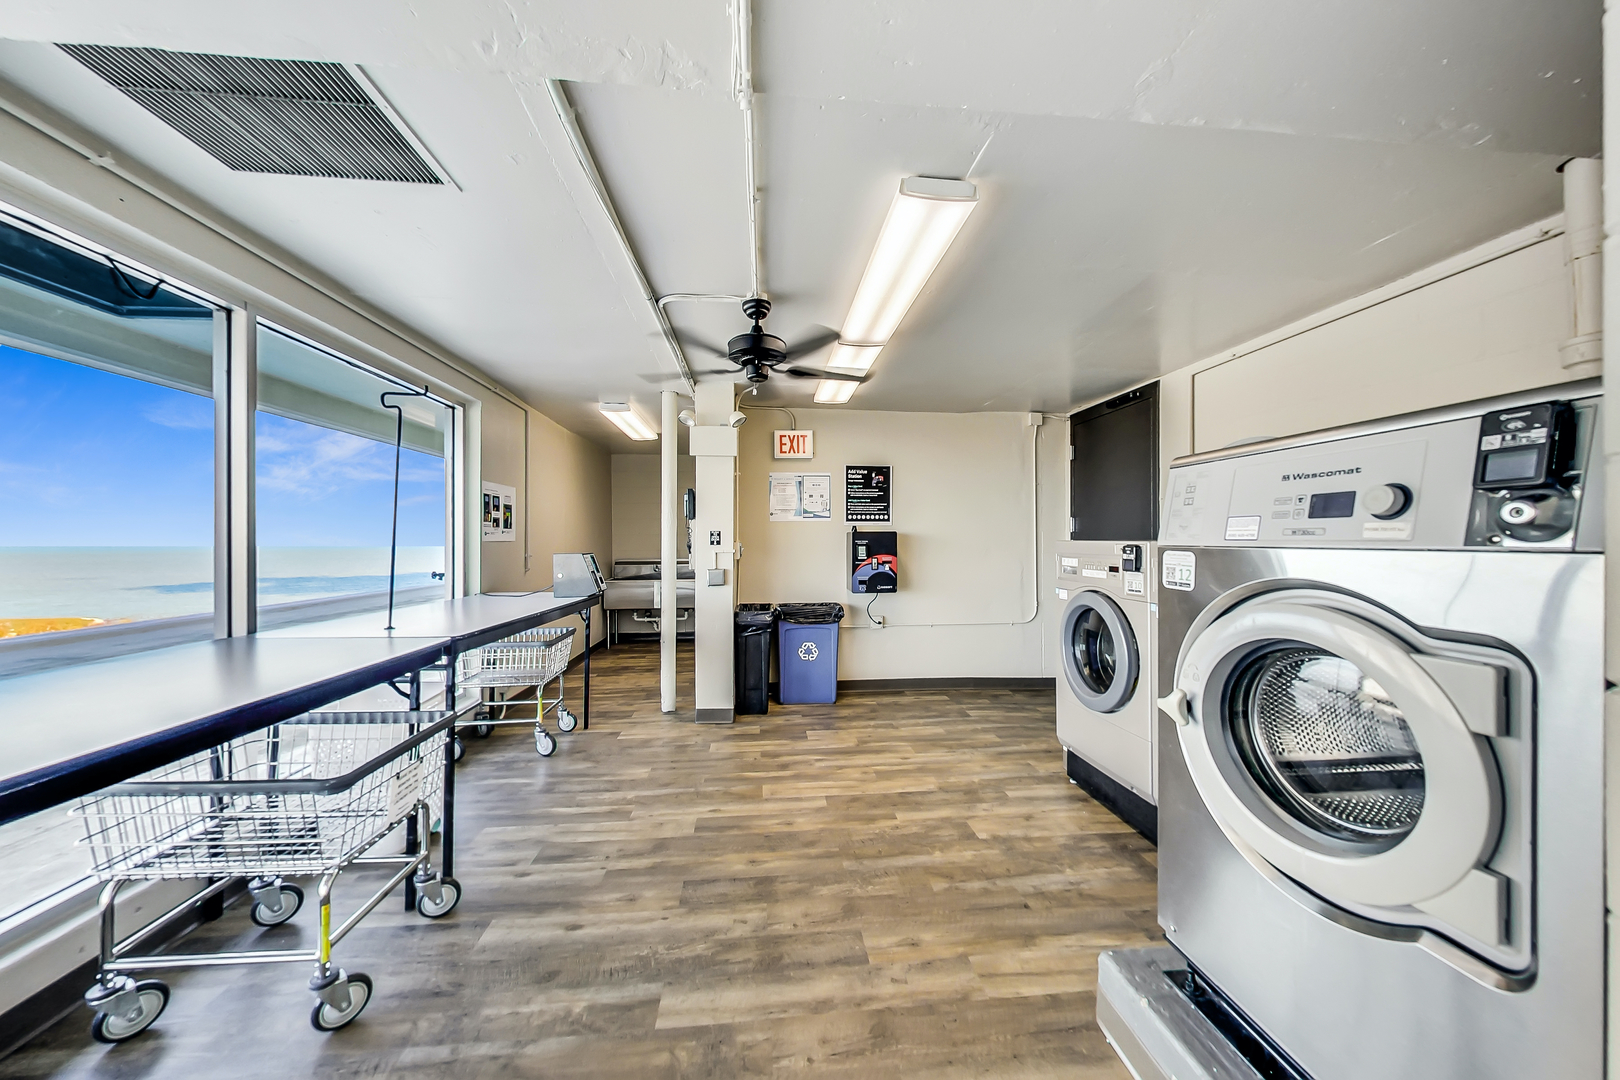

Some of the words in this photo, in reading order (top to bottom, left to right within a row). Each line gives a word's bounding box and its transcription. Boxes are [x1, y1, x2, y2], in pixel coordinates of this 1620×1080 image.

[779, 434, 807, 454] EXIT
[1292, 467, 1362, 480] Wascomat
[1179, 568, 1192, 582] 12
[1134, 581, 1142, 589] 10
